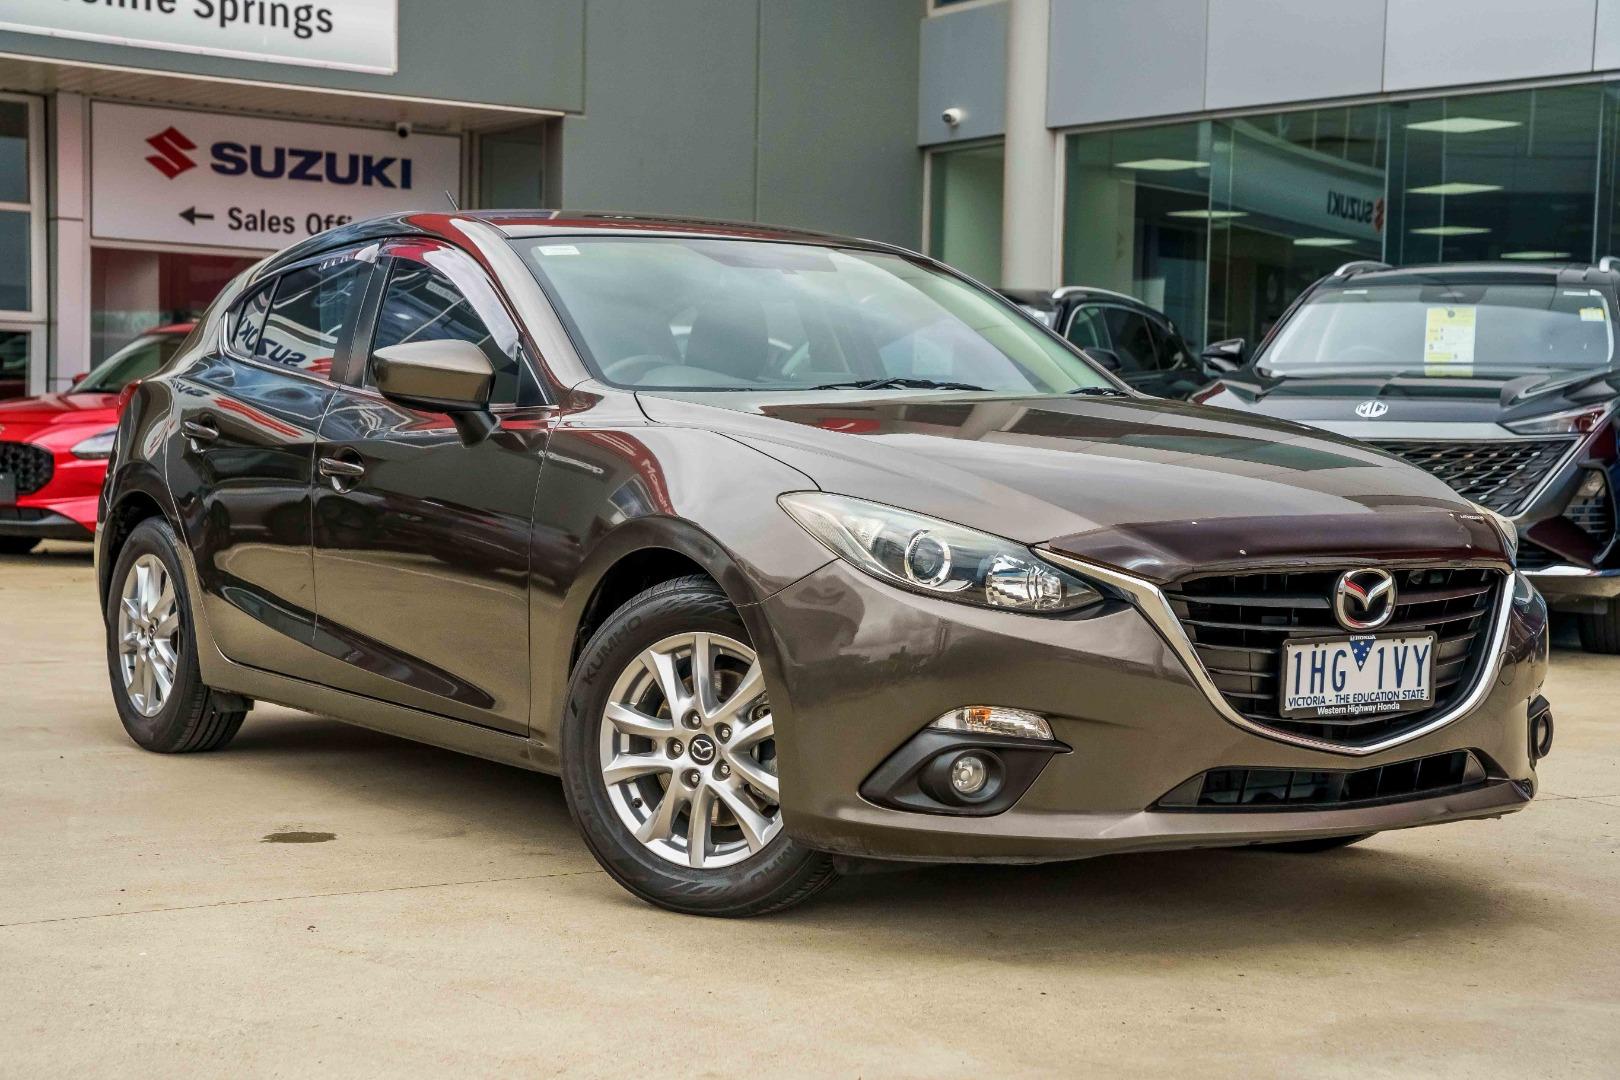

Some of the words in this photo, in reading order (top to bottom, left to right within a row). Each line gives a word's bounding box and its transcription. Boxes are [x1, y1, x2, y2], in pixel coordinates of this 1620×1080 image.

[193, 0, 334, 39] Springs
[210, 141, 412, 190] SUZUKI
[227, 206, 296, 234] Sales
[305, 212, 352, 236] Off
[1294, 649, 1348, 695] 1HG
[1377, 644, 1430, 690] 1VY
[1288, 694, 1326, 707] VICTORIA
[1335, 693, 1351, 704] THE
[1352, 690, 1400, 703] EDUCATION
[1402, 688, 1425, 700] STATE
[1317, 706, 1347, 715] Western
[1347, 704, 1377, 714] Highway
[1377, 701, 1400, 711] Honda
